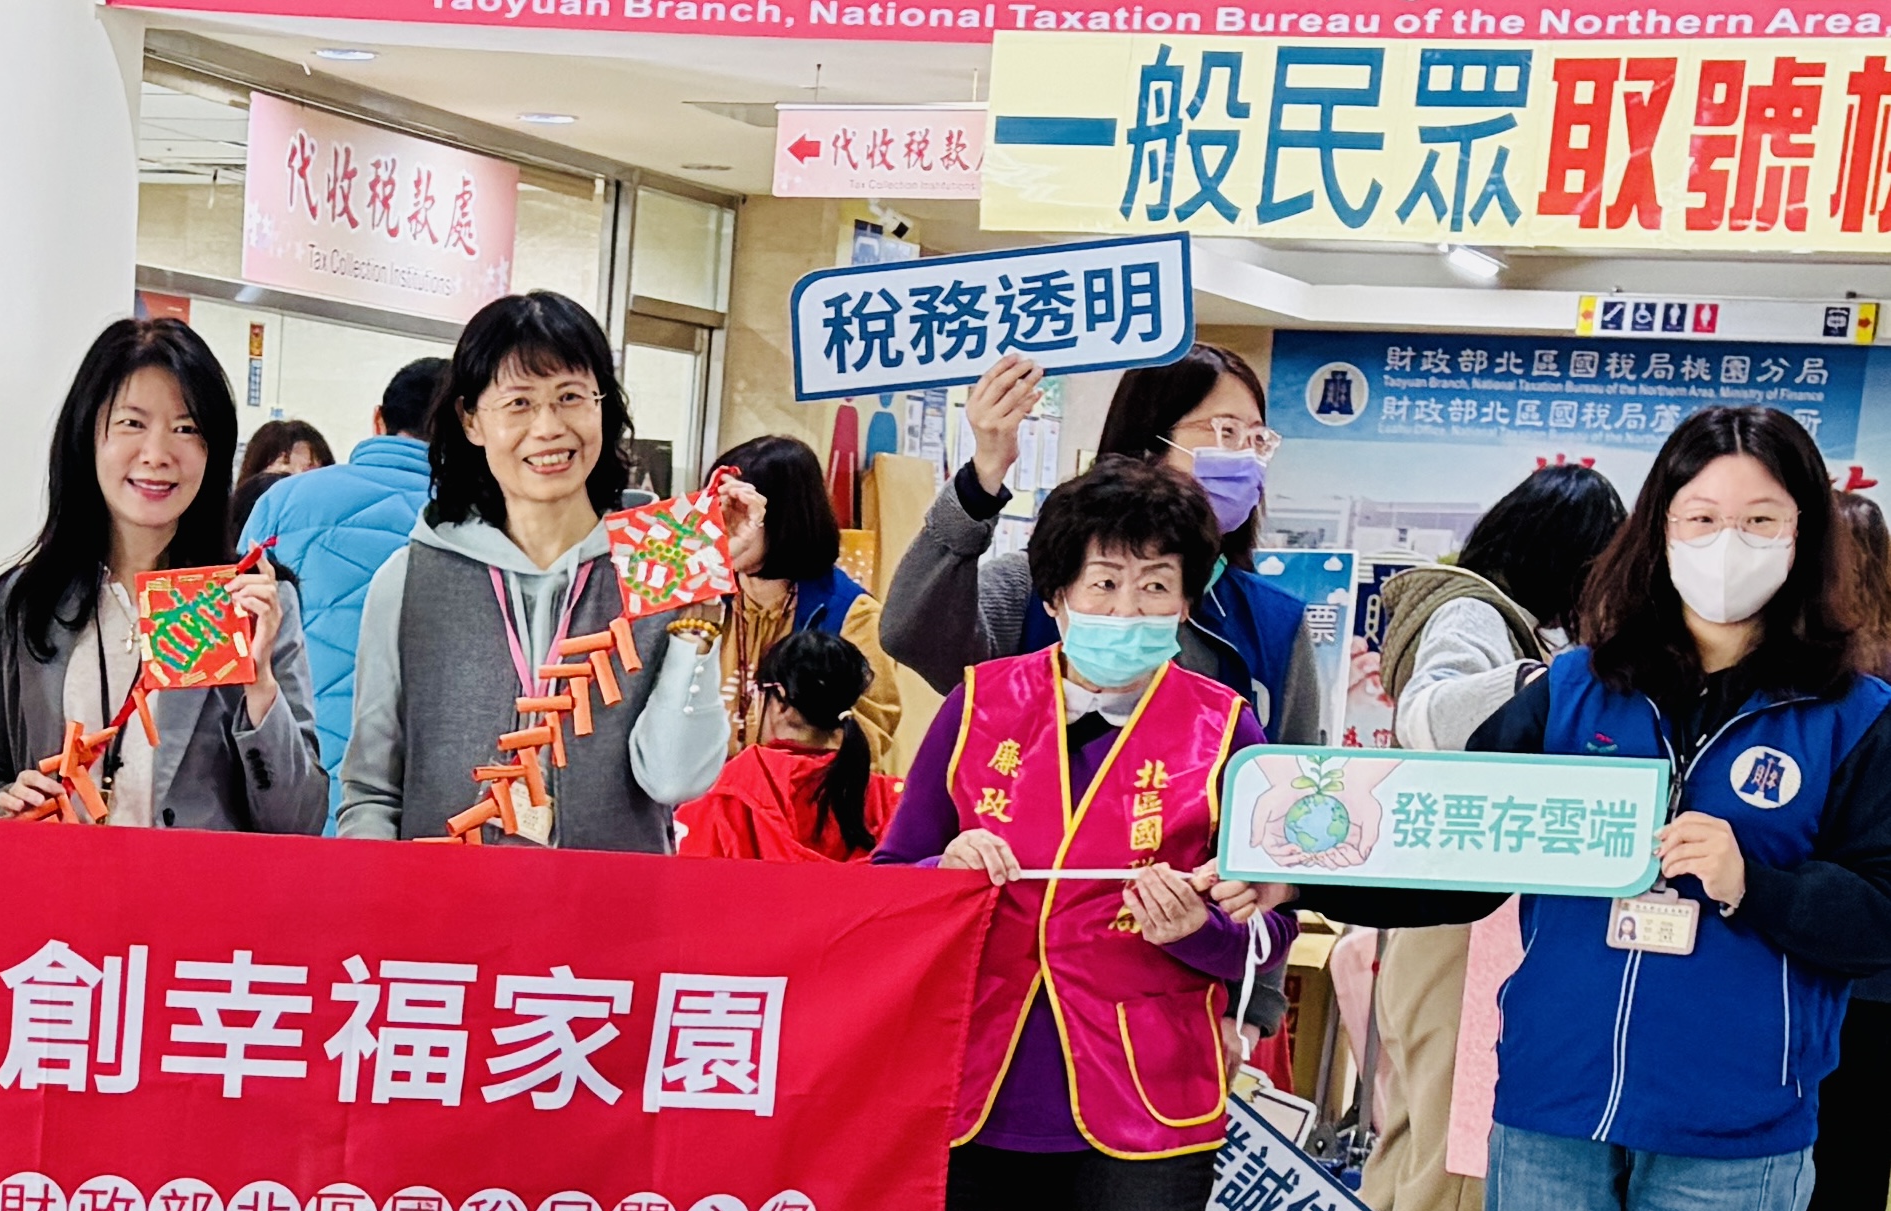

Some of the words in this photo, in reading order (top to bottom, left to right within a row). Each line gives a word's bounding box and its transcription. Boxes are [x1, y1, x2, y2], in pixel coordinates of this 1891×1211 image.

[624, 0, 795, 28] Branch,
[810, 0, 993, 28] National
[1009, 4, 1201, 32] Taxation
[1216, 6, 1380, 34] Bureau
[1394, 8, 1440, 34] of
[1451, 8, 1525, 34] the
[1539, 8, 1752, 34] Northern
[308, 243, 327, 271] Tax
[330, 248, 388, 284] Collection
[390, 258, 453, 297] Institutions
[822, 262, 1164, 374] 稅務透明
[1383, 346, 1830, 387] 財政部北區國稅局桃園分局
[974, 738, 1023, 823] 廉政
[1391, 790, 1637, 859] 發票存雲端
